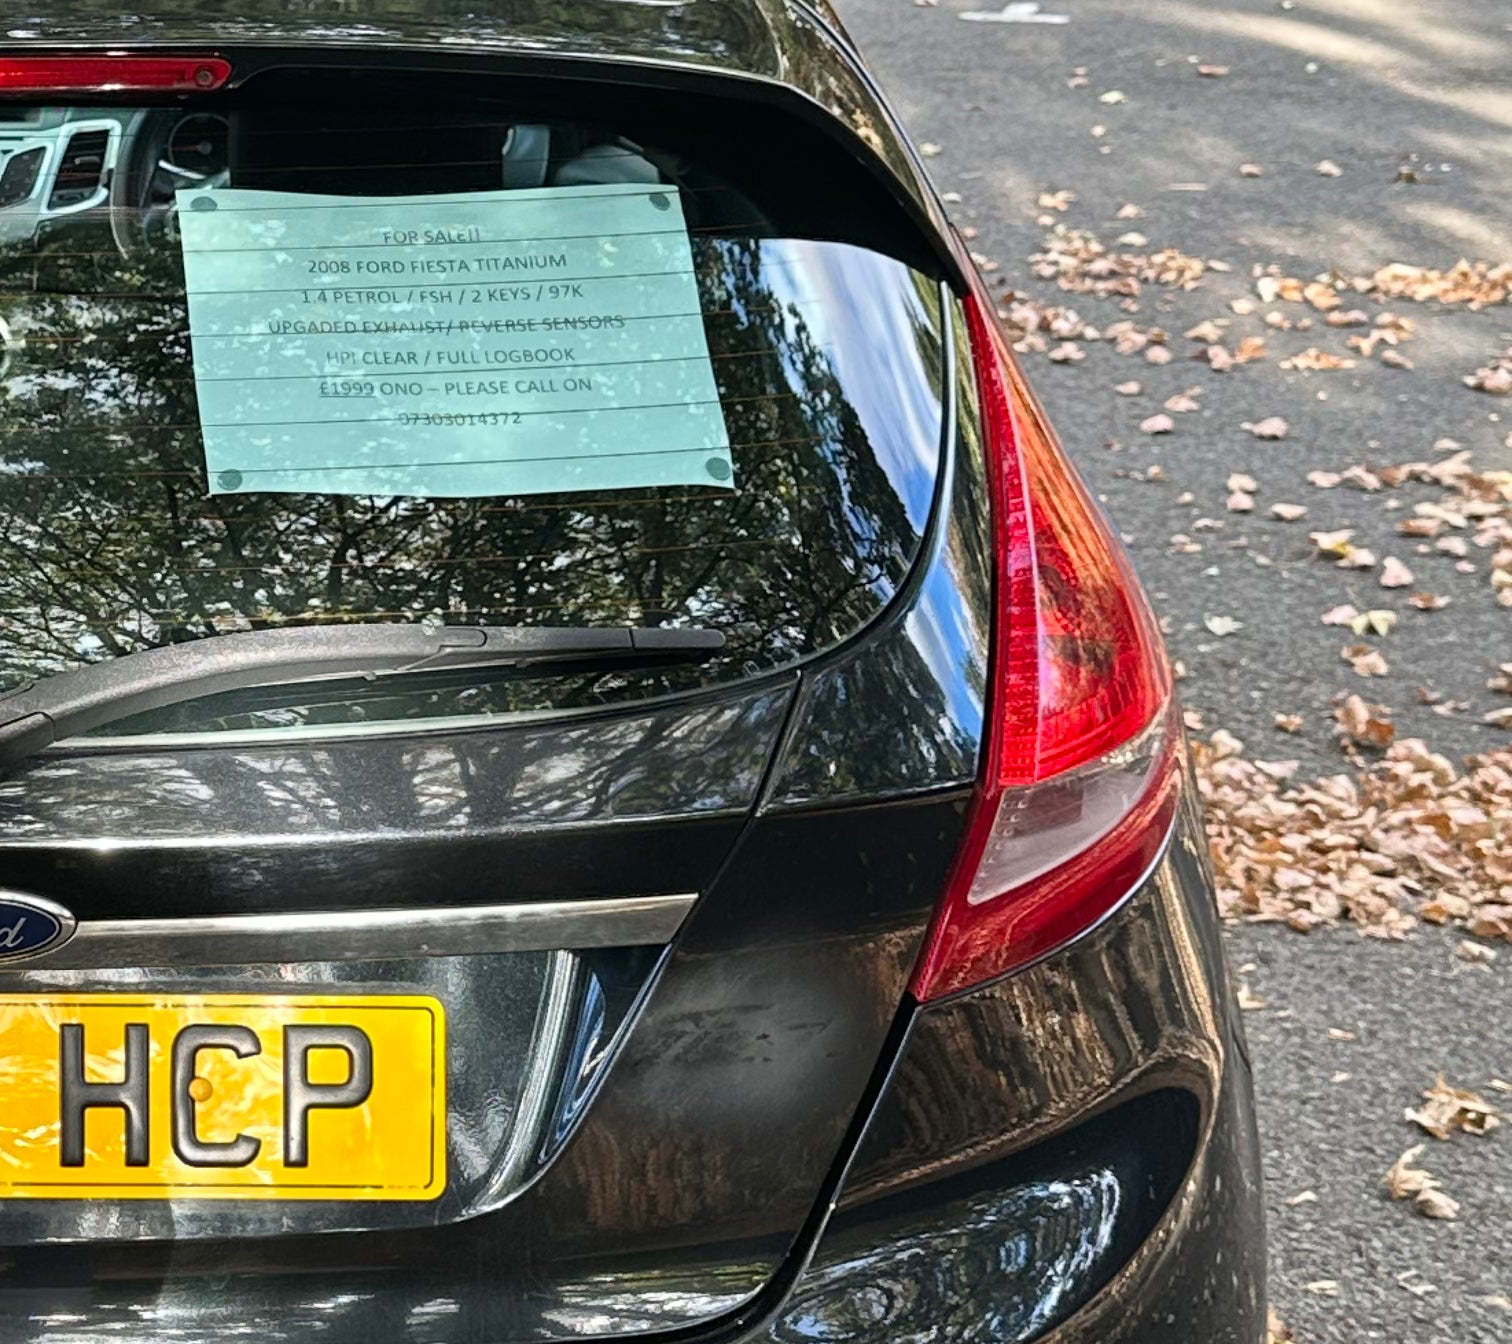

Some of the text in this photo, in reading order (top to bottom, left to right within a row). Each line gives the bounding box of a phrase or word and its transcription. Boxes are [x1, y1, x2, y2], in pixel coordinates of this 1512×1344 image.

[383, 230, 418, 245] FOR
[308, 254, 567, 274] 2008 FORD FIESTA TITANIUM
[302, 289, 327, 304] 1.4
[333, 289, 399, 304] PETROL
[420, 289, 452, 304] FSH
[471, 289, 482, 303] 2
[488, 287, 531, 302] KEYS
[548, 283, 584, 299] 97K
[268, 320, 356, 335] UPGADED
[459, 318, 538, 335] REVERSE
[542, 314, 626, 331] SENSORS
[326, 351, 356, 365] HPI
[362, 351, 419, 365] CLEAR
[436, 350, 480, 365] FULL
[484, 348, 576, 364] LOGBOOK
[318, 382, 375, 396] £1999
[379, 382, 423, 396] ONO
[444, 380, 510, 395] PLEASE
[514, 379, 559, 394] CALL
[563, 377, 593, 392] ON
[58, 1023, 374, 1168] HCP
